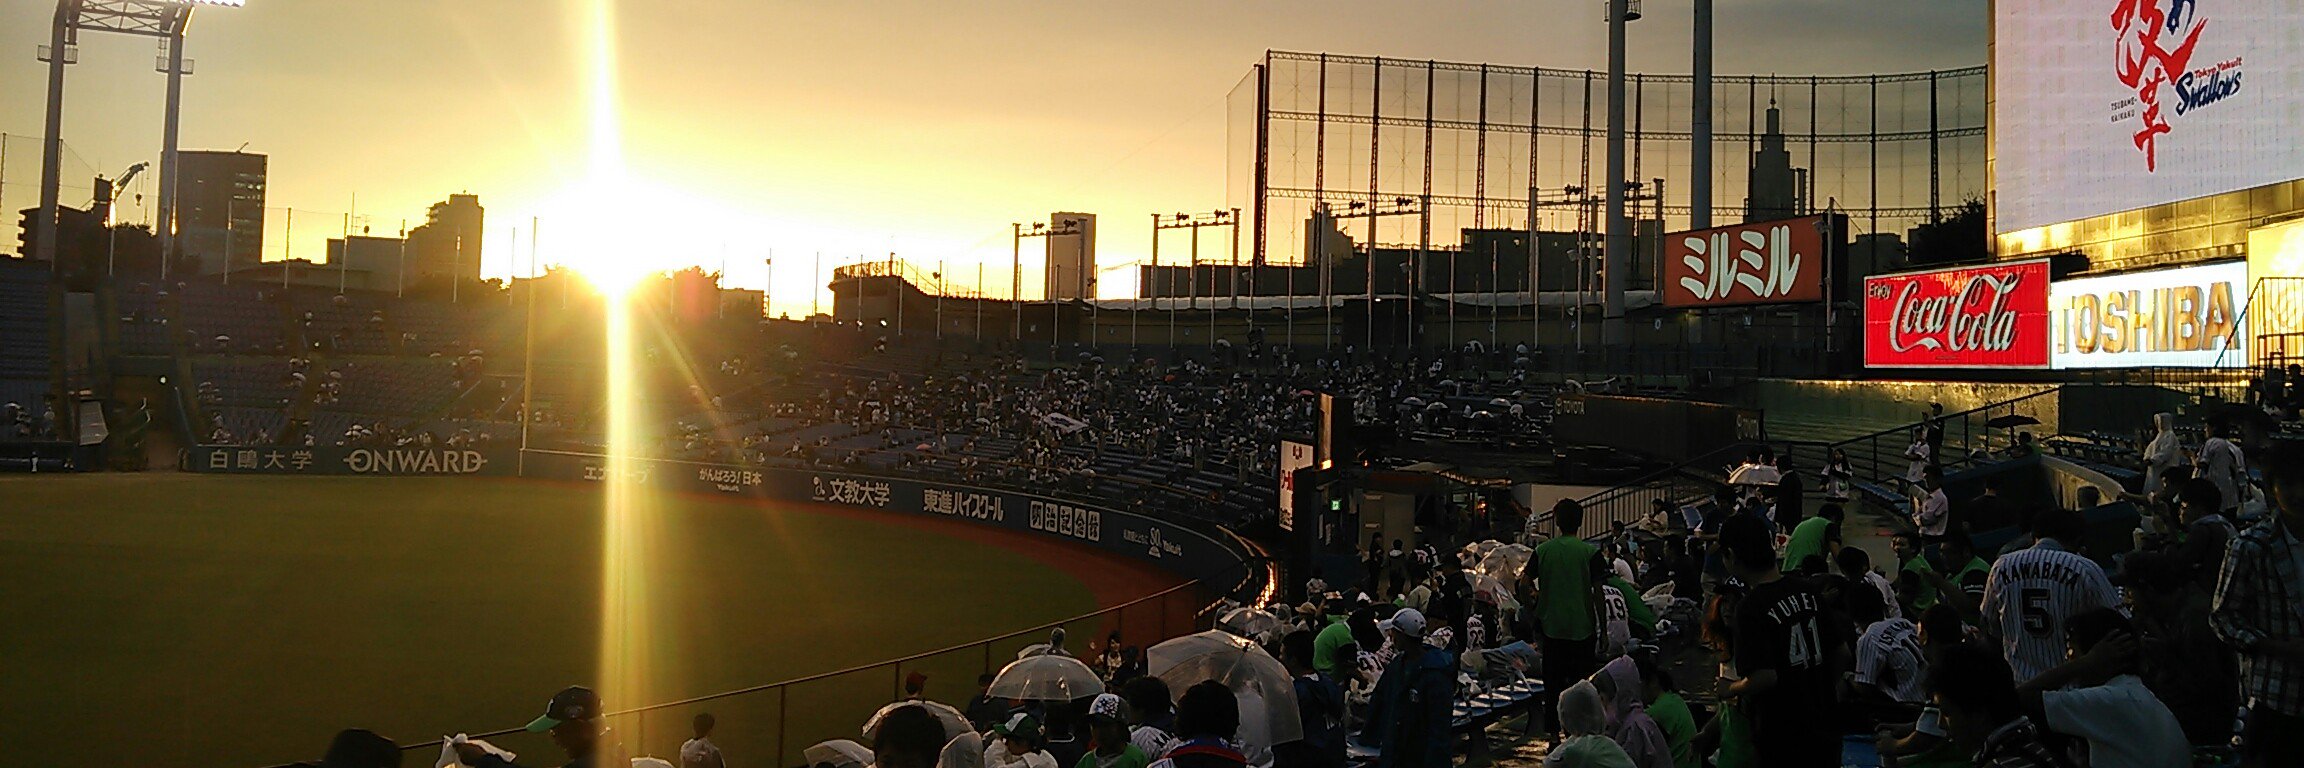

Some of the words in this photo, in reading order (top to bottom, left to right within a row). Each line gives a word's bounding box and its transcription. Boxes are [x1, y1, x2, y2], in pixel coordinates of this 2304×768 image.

[2194, 68, 2217, 80] Tokyo
[2217, 56, 2243, 72] Yakult
[2175, 70, 2242, 116] Swallows
[1680, 224, 1801, 301] ミルミル
[1890, 269, 2023, 354] Coca-Cola
[2049, 281, 2240, 354] TOSHIBA
[344, 448, 487, 474] ONWARD
[829, 478, 891, 507] 文教大学
[923, 488, 1005, 522] 東進ハイスクール
[1999, 561, 2082, 590] KAWABATA
[1605, 598, 1626, 620] 19
[1767, 592, 1818, 625] YUHEI
[2021, 588, 2051, 637] 5
[1788, 616, 1824, 670] 41
